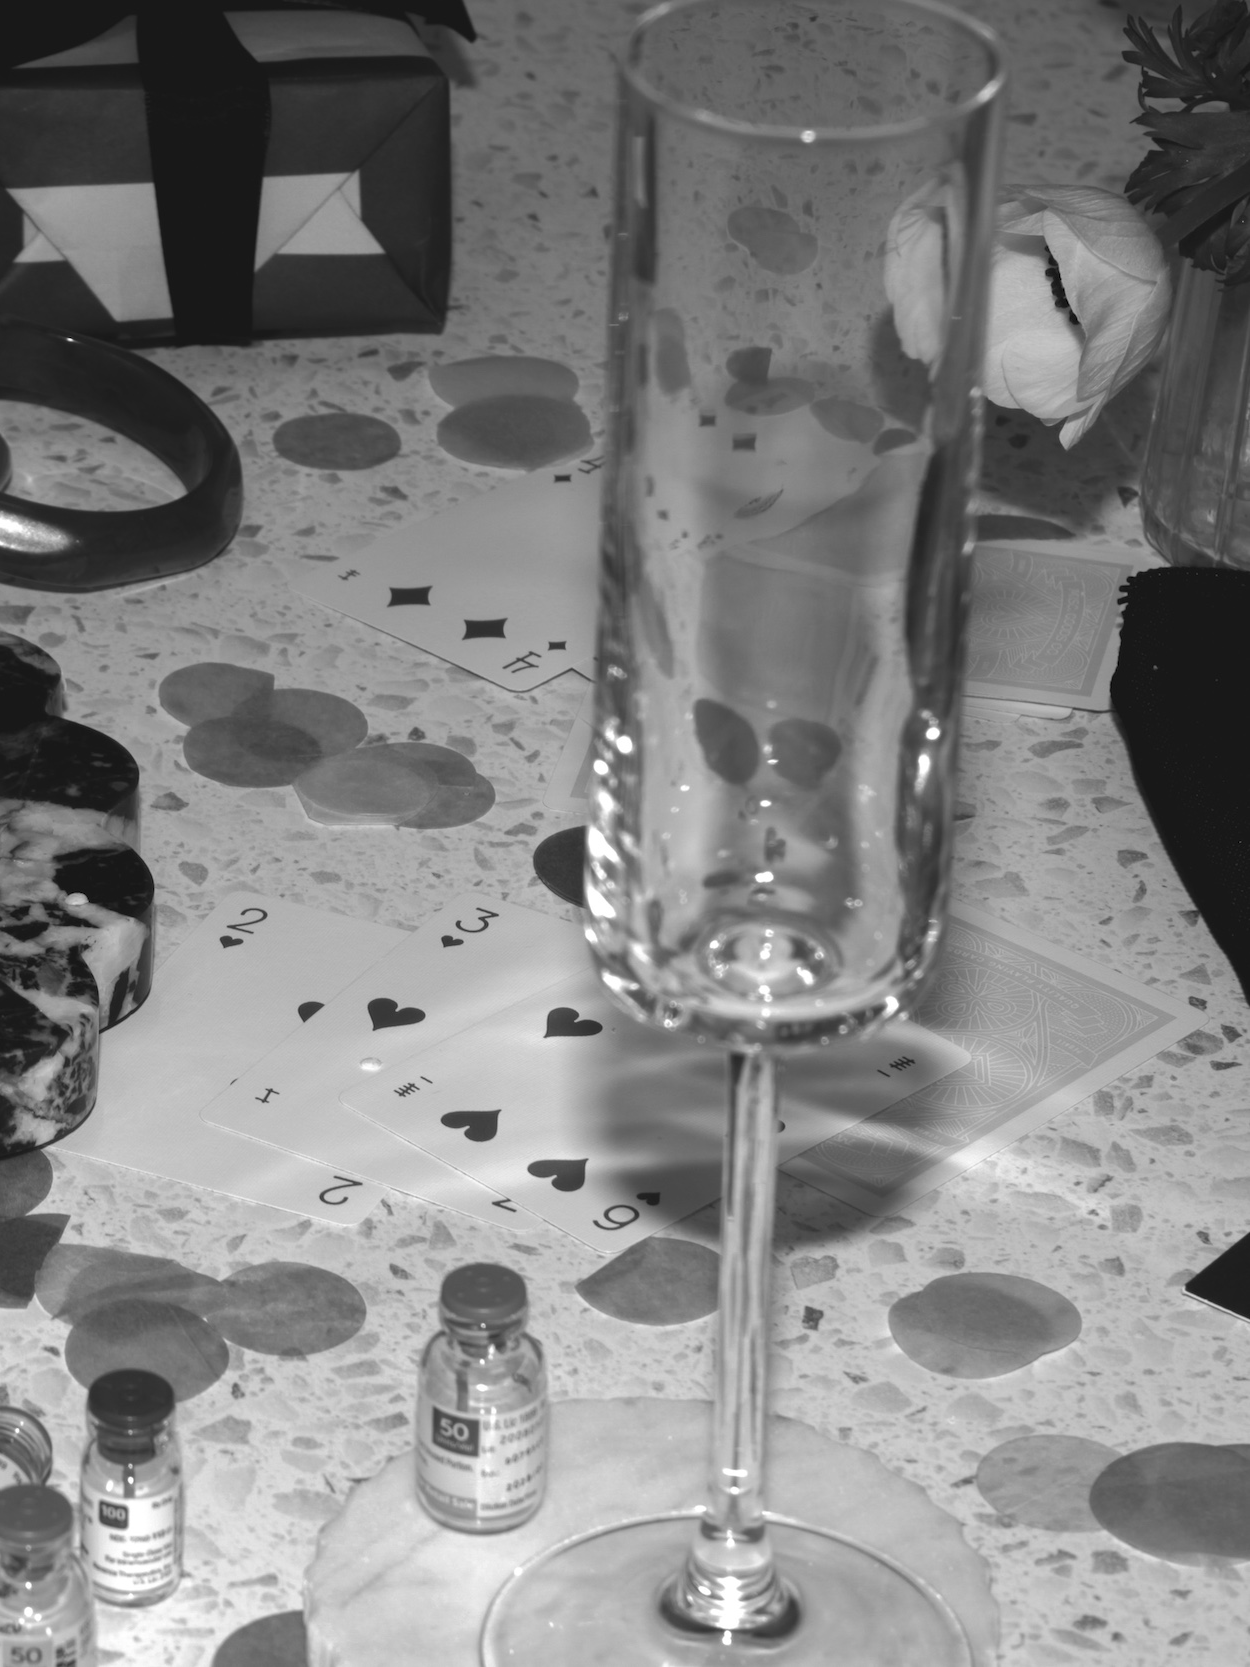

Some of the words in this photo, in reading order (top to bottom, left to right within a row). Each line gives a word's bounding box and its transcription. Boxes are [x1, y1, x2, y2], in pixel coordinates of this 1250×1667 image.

[226, 907, 269, 934] 2
[455, 906, 500, 933] 3
[988, 961, 1035, 984] PLAYING
[1037, 983, 1080, 1009] QUALITY
[318, 1175, 363, 1207] 2
[440, 1417, 469, 1442] 50
[101, 1504, 127, 1521] 100
[11, 1646, 43, 1665] 50
